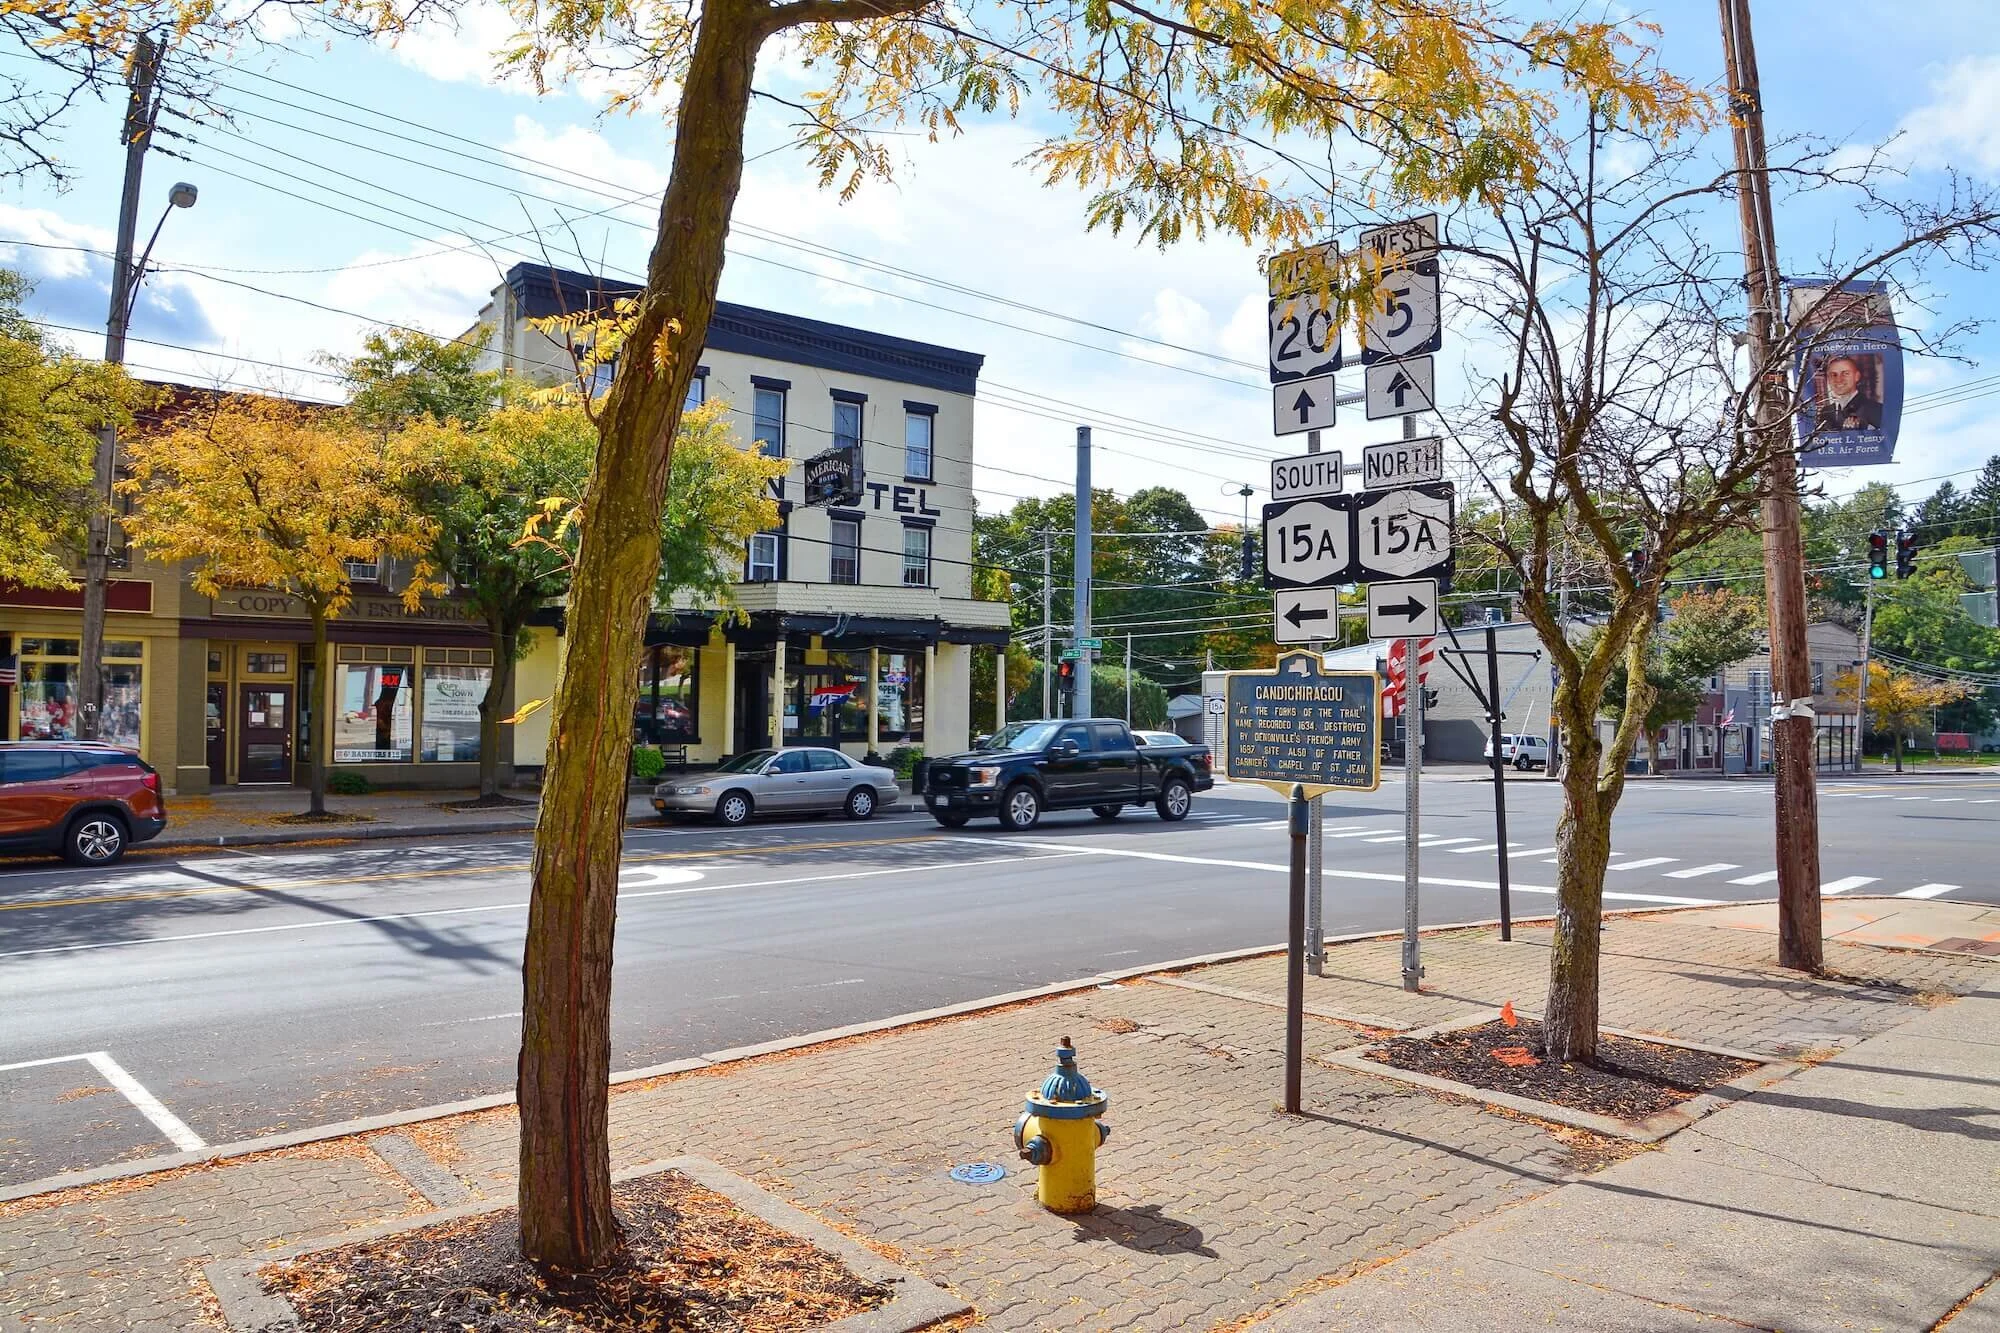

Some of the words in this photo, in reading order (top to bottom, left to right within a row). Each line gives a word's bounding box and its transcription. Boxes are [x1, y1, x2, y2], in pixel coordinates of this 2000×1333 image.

[1386, 287, 1413, 338] 5
[1276, 308, 1335, 362] 20
[1811, 343, 1860, 352] ometown
[1863, 342, 1888, 351] Hero
[1812, 436, 1843, 445] Robert
[1845, 435, 1855, 444] L.
[1817, 446, 1837, 455] U.S.
[1839, 446, 1854, 454] Air
[1855, 445, 1880, 454] Force
[1367, 447, 1438, 480] NORTH
[807, 459, 851, 487] AMERICAN
[818, 473, 839, 484] HOTEL
[1276, 460, 1339, 491] SOUTH
[1370, 513, 1437, 556] 15A
[1277, 523, 1337, 564] 15A
[238, 595, 294, 612] COPY
[1255, 706, 1269, 716] THE
[1274, 706, 1297, 717] FORKS
[1303, 707, 1313, 718] OF
[1318, 708, 1332, 718] THE
[1235, 719, 1253, 728] NAME
[1258, 719, 1292, 730] RECORDED
[1298, 721, 1318, 731] 1634.
[1324, 721, 1367, 733] DESTROYED
[1239, 732, 1249, 741] BY
[1306, 734, 1334, 745] FRENCH
[1341, 736, 1362, 747] ARMY
[1263, 746, 1280, 756] SITE
[1288, 747, 1307, 758] ALSO
[1315, 748, 1326, 759] OF
[1333, 749, 1362, 761] FATHER
[1278, 760, 1305, 771] CHAPEL
[1312, 761, 1322, 771] OF
[1346, 763, 1369, 775] JEAN.
